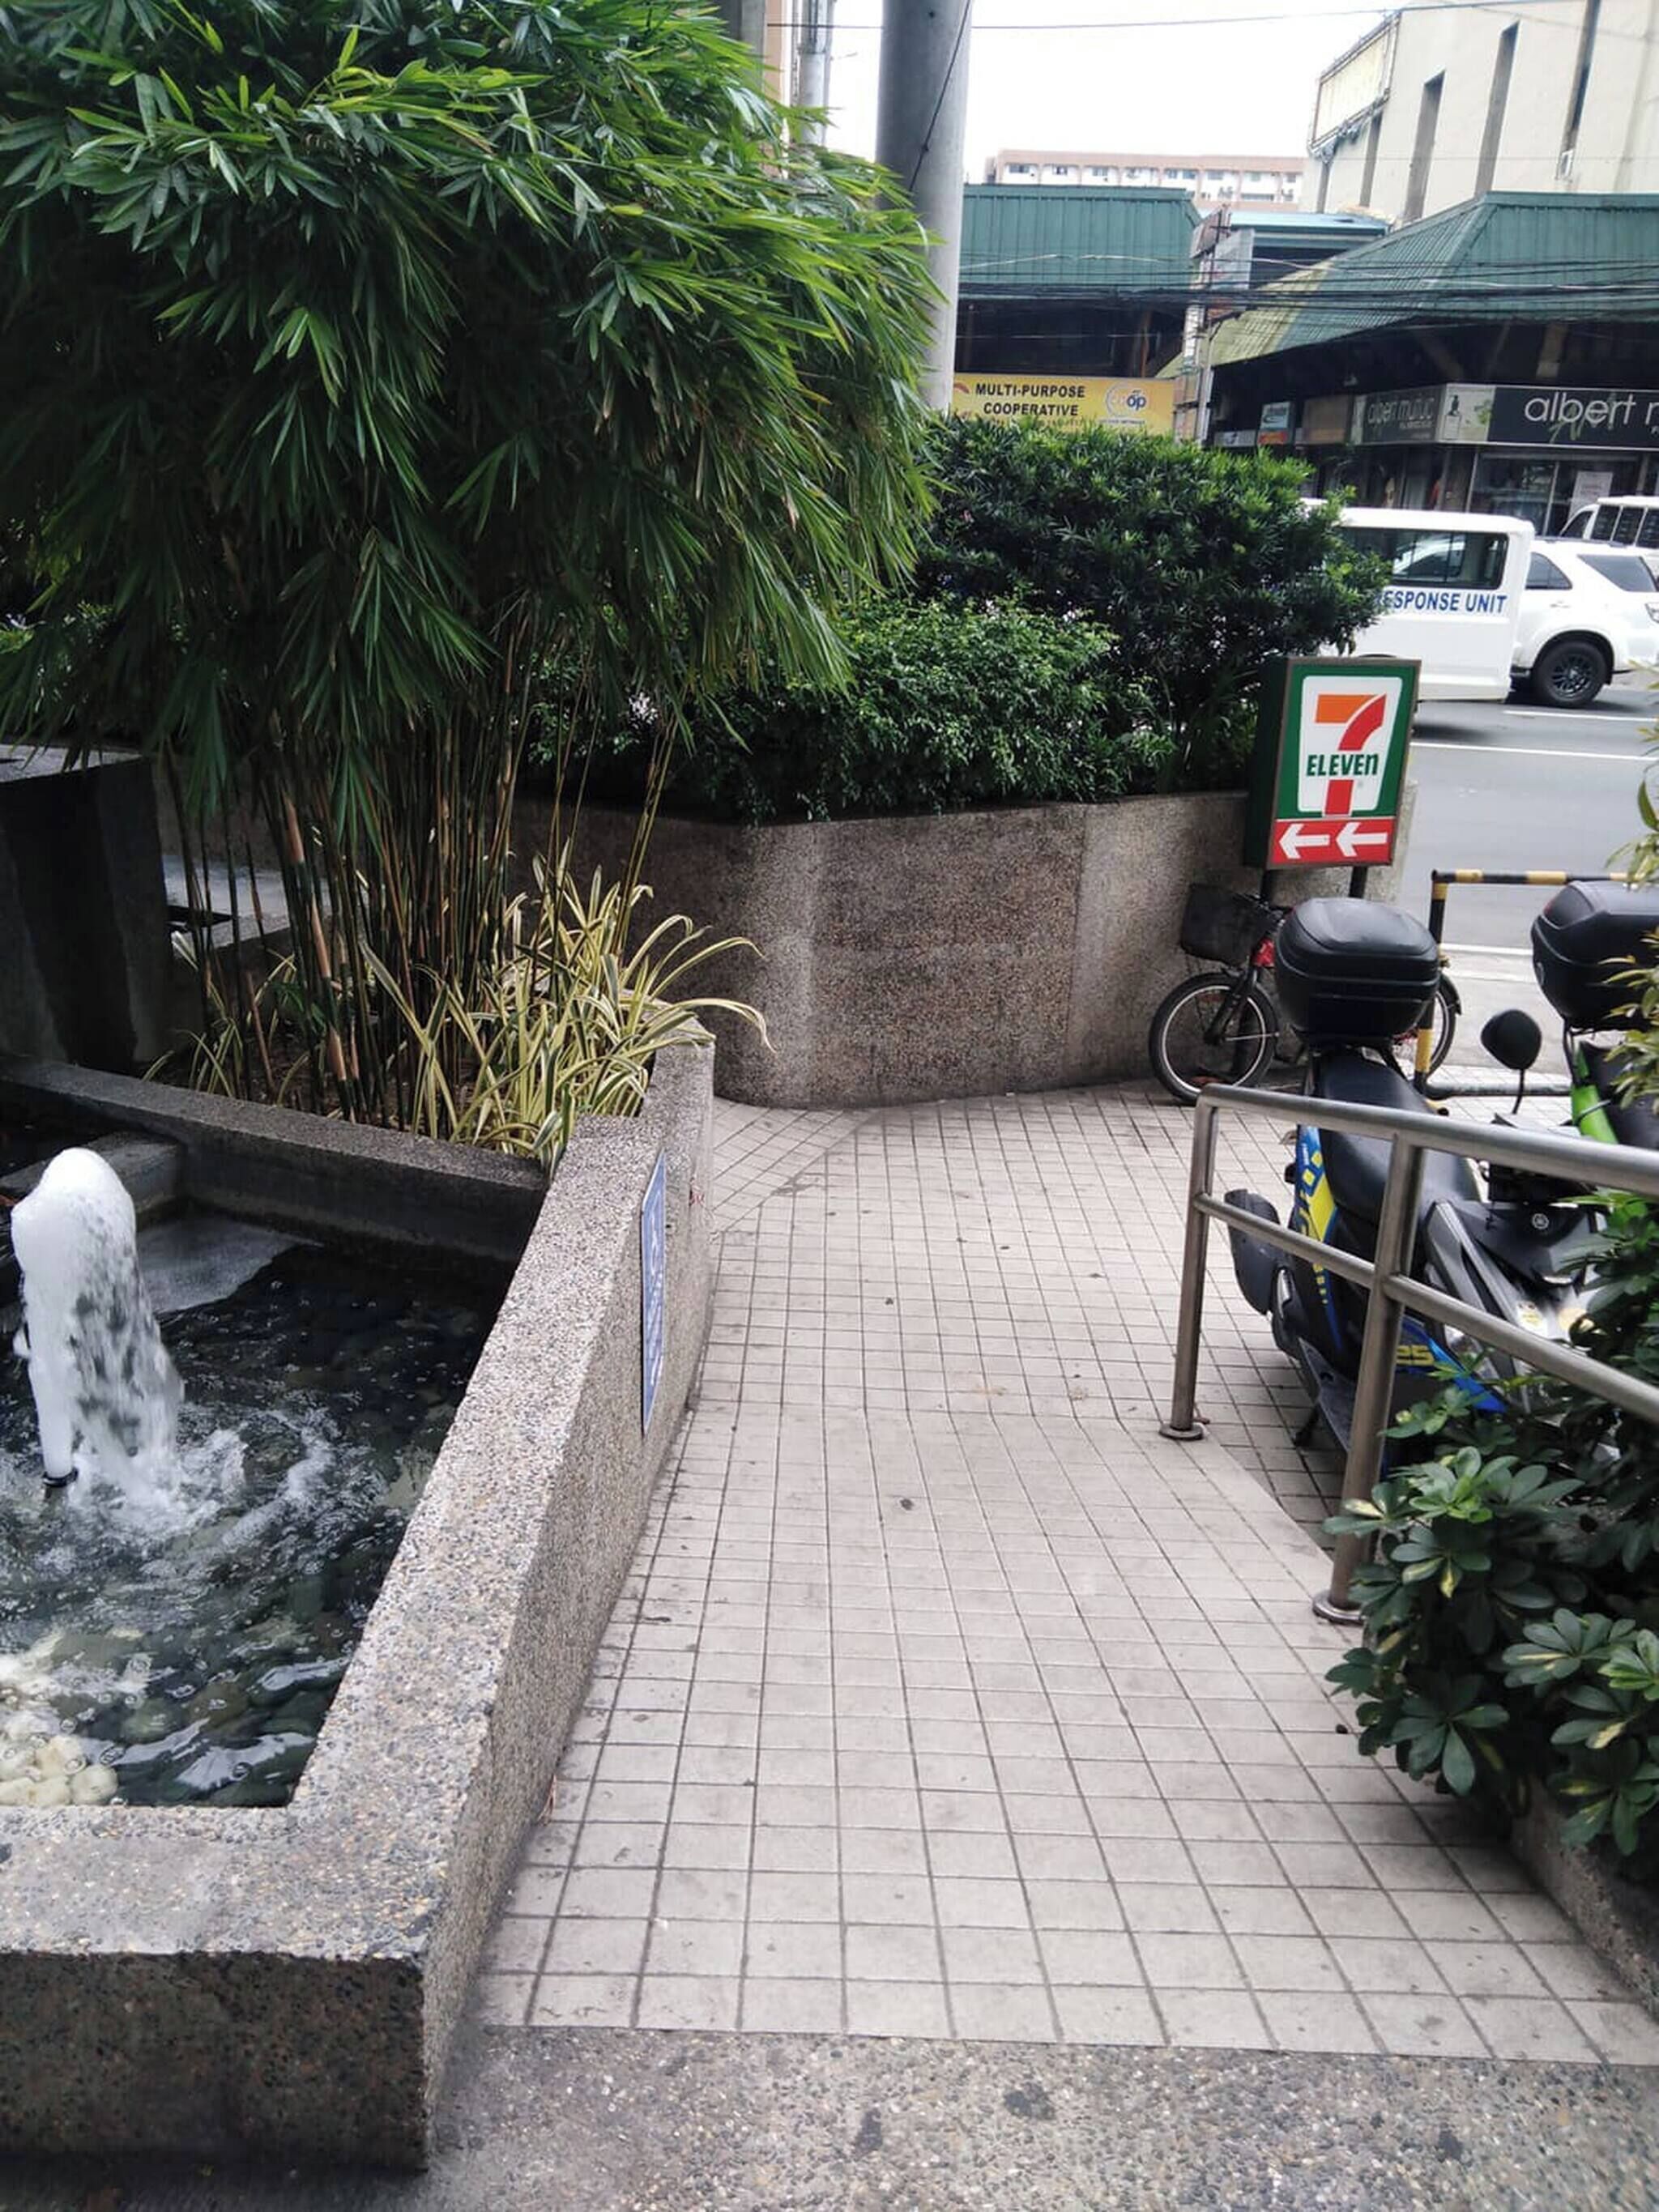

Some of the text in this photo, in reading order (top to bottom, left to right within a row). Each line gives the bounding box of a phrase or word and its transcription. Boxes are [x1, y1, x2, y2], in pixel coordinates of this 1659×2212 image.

[975, 383, 1085, 398] MULTI-PURPOSE
[983, 403, 1078, 416] COOPERATIVE
[1525, 391, 1636, 424] albert
[1465, 592, 1507, 613] UNIT
